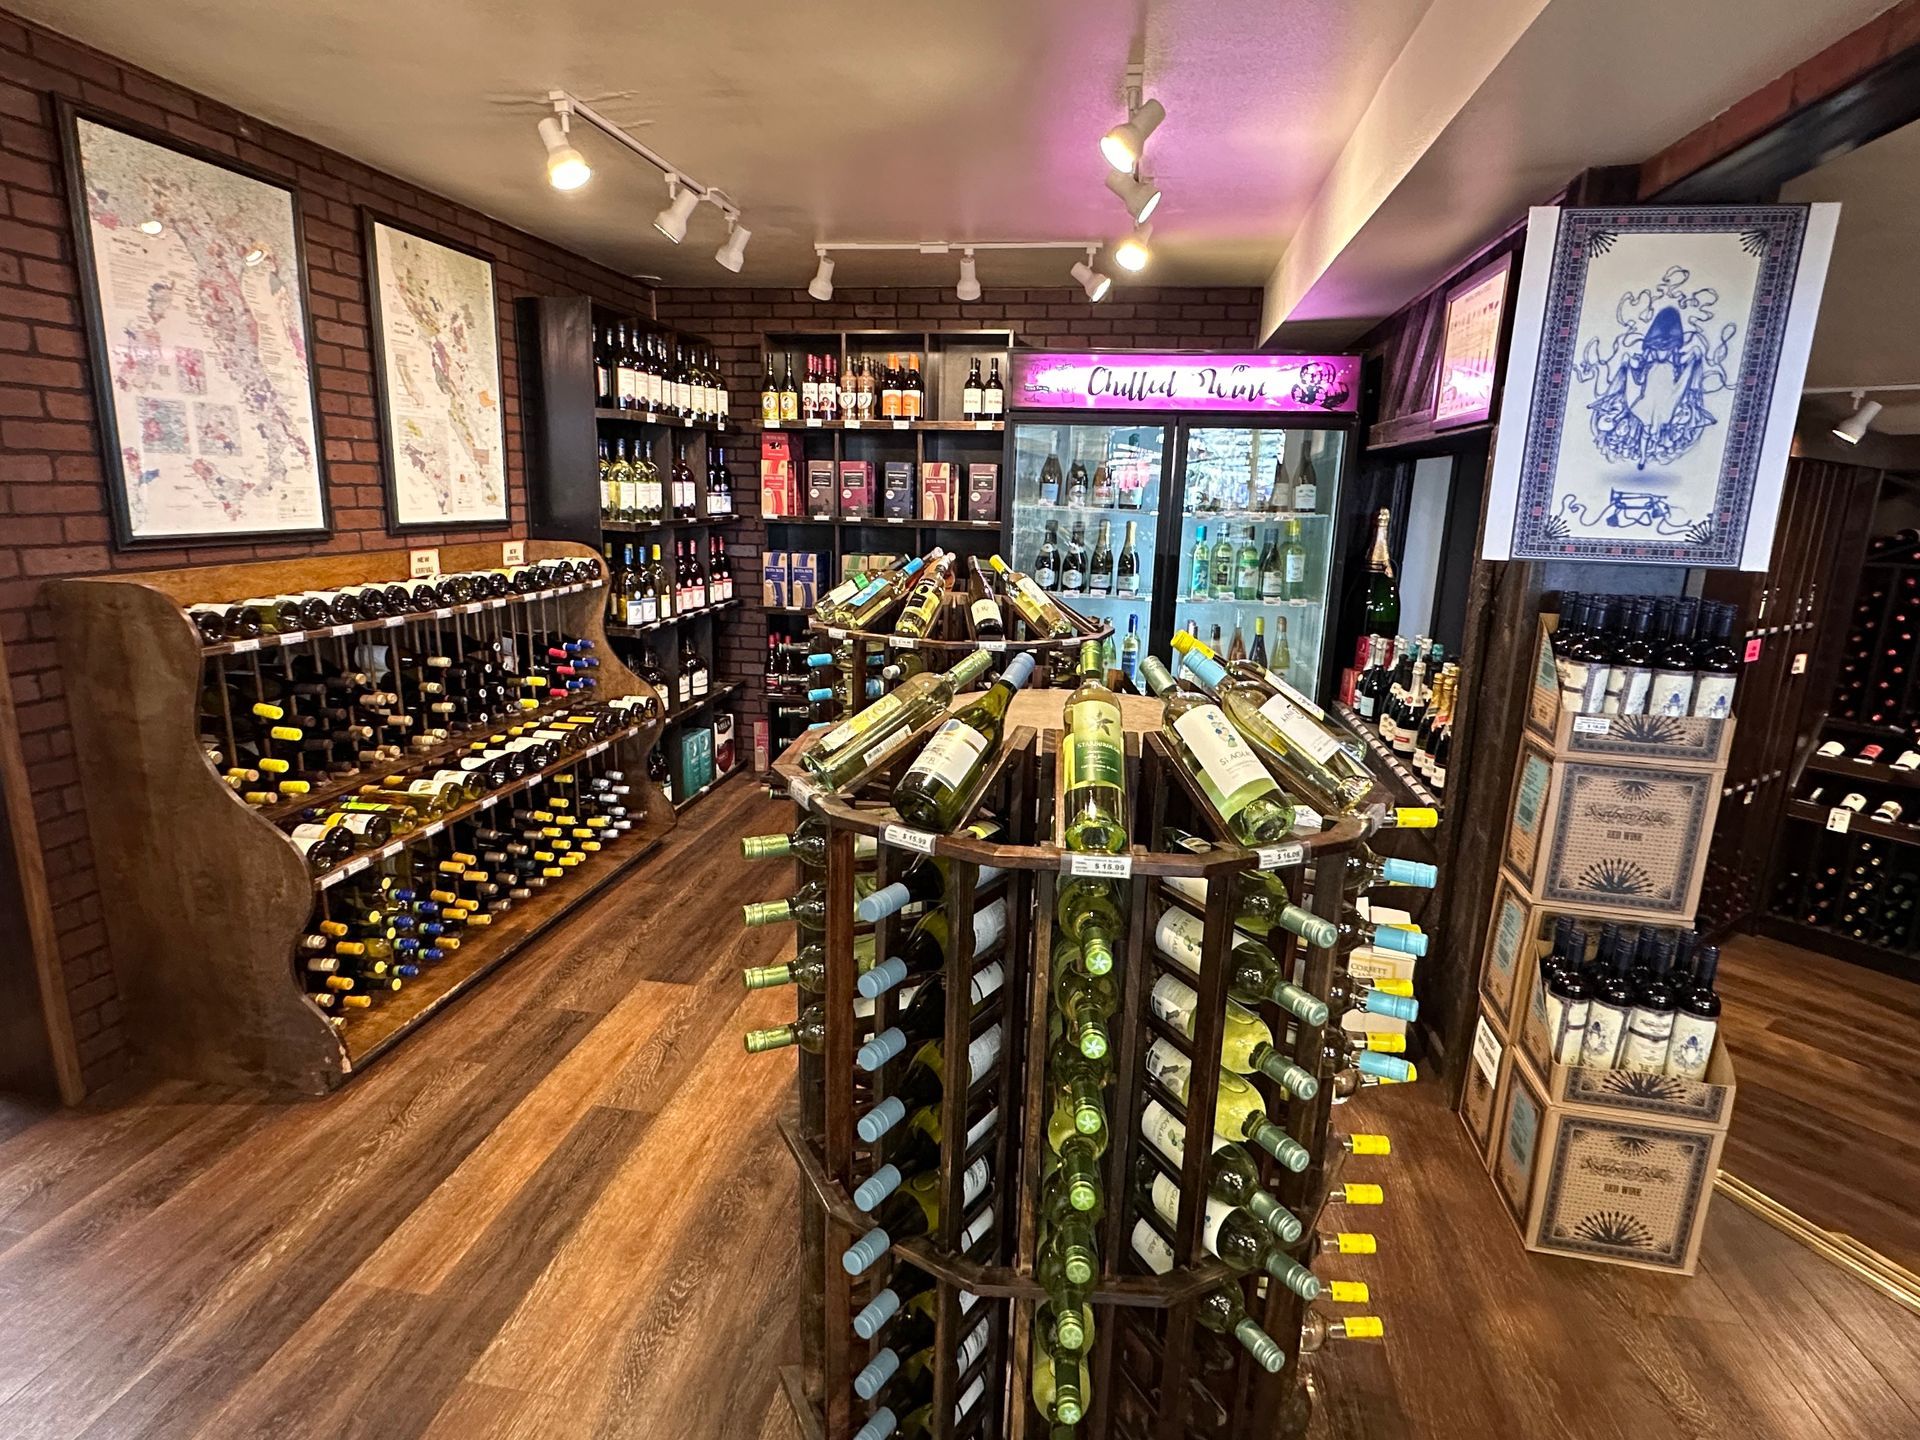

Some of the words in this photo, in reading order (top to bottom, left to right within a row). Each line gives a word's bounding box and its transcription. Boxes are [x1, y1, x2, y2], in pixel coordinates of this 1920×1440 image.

[1087, 366, 1177, 400] Chilled
[1197, 364, 1268, 402] Wine
[1623, 831, 1643, 841] WINE
[1351, 962, 1387, 974] CORBETT
[1621, 1185, 1642, 1196] WINE
